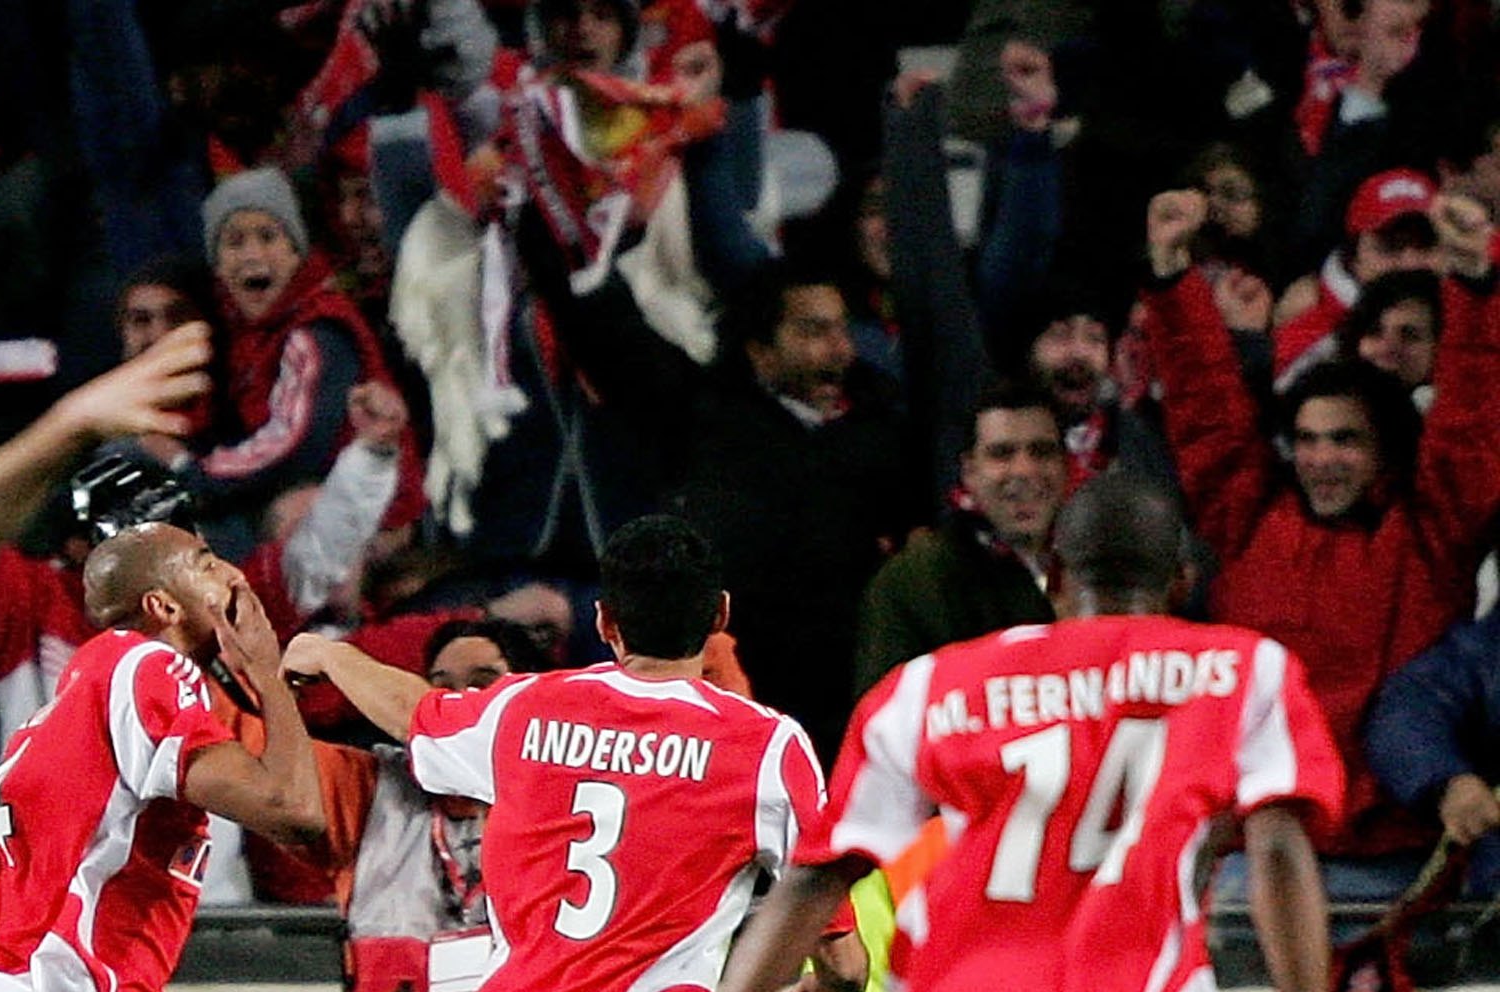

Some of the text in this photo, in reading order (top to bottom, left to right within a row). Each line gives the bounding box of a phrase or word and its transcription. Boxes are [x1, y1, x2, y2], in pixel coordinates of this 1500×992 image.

[521, 717, 713, 782] ANDERSON
[984, 717, 1169, 903] 14
[553, 780, 627, 941] 3
